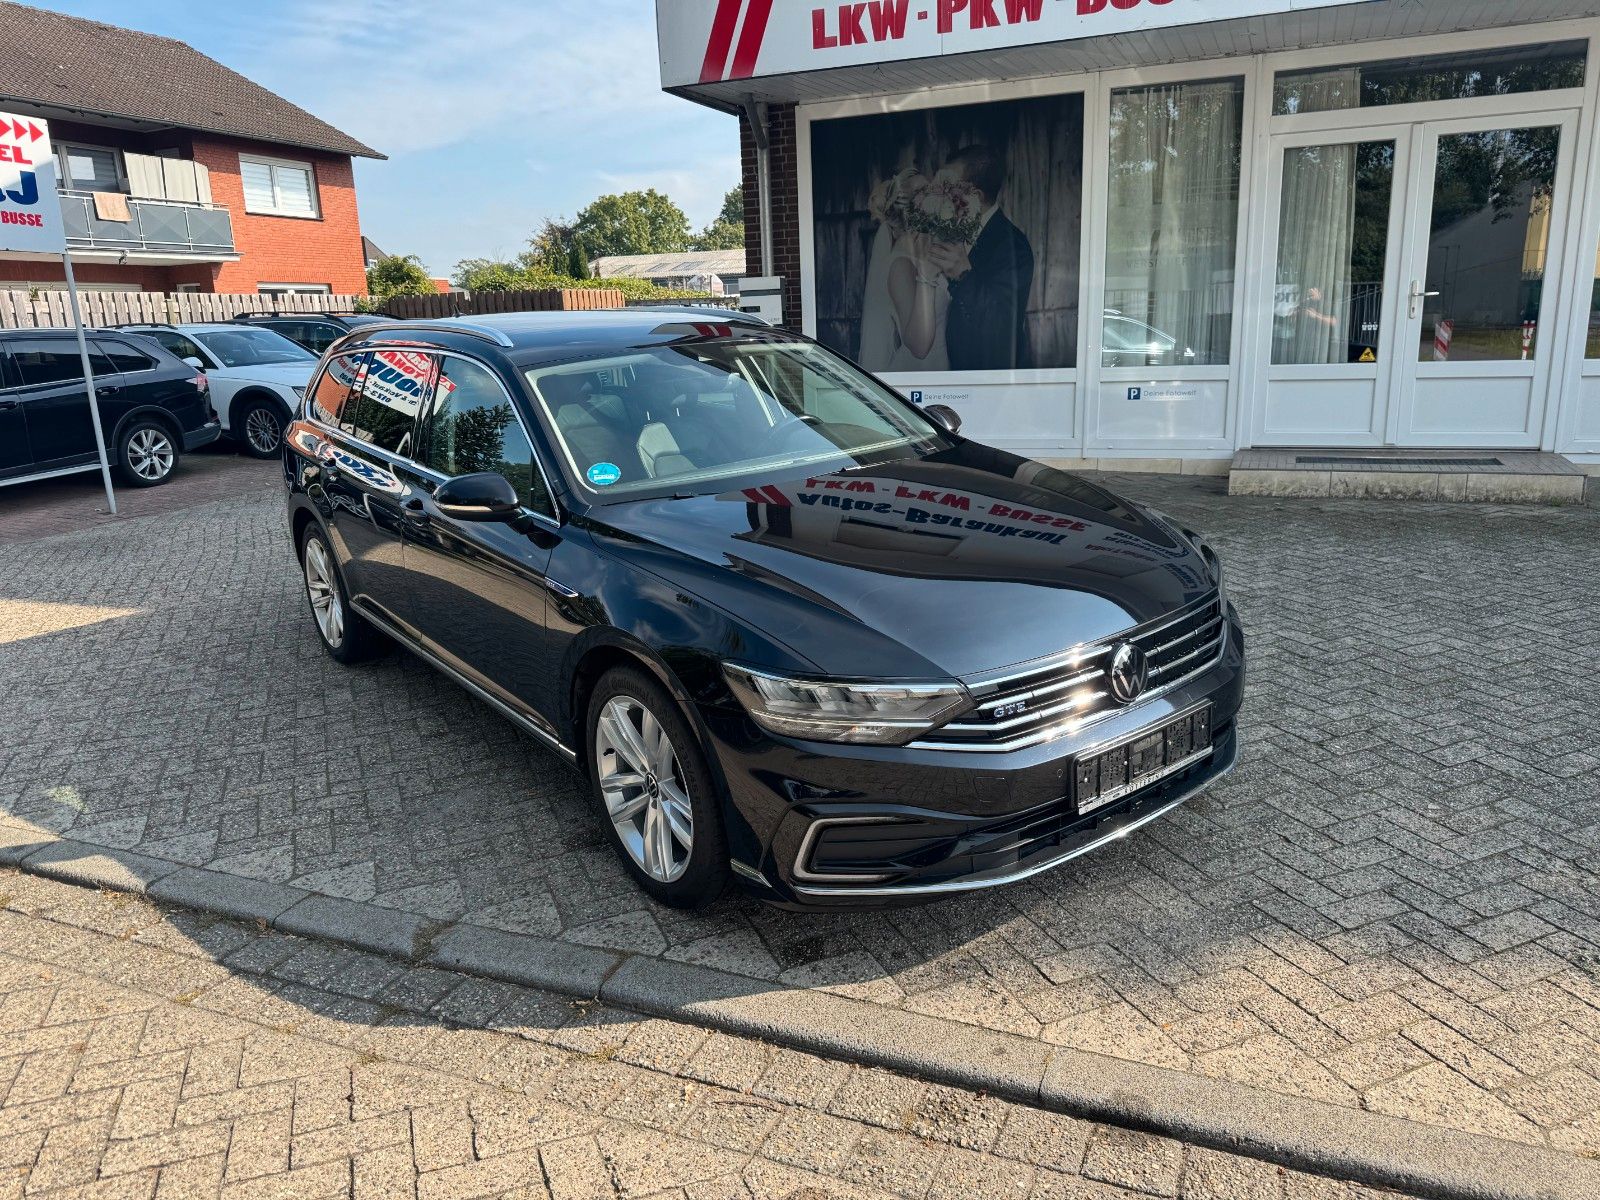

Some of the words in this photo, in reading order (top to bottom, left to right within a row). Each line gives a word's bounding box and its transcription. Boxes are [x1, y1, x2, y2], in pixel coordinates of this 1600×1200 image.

[812, 0, 909, 49] LKW
[937, 0, 1043, 34] PKW
[1, 210, 43, 227] BUSSE
[993, 701, 1026, 718] GTE
